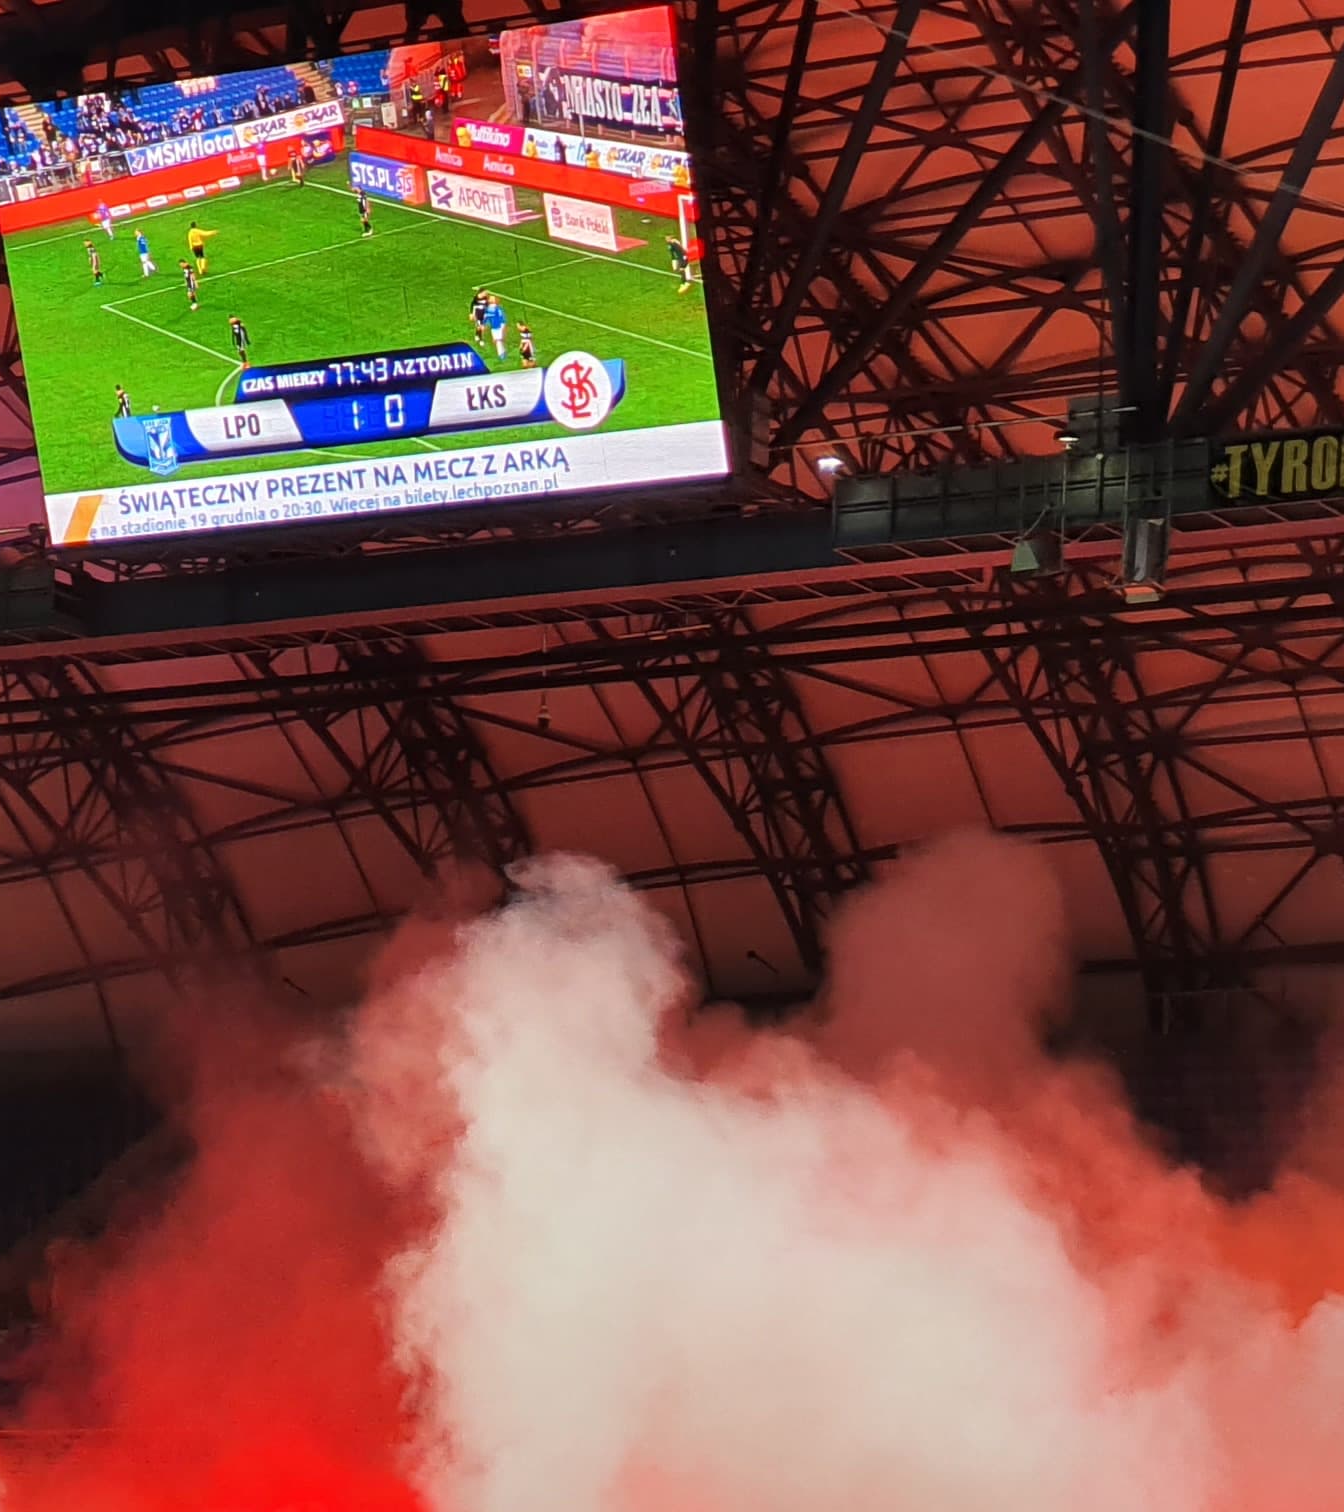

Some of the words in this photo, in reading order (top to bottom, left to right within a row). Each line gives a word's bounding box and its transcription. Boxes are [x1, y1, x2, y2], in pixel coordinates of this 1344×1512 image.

[146, 135, 235, 169] MSMflota
[351, 161, 394, 192] STS.PL
[458, 187, 504, 215] AFORTI
[241, 375, 274, 394] CZAS
[276, 370, 325, 389] MIERZY
[328, 357, 389, 387] 77:43
[392, 350, 476, 376] AZTORIN
[383, 394, 404, 429] 0
[466, 383, 507, 411] ŁKS
[222, 413, 261, 440] LPO
[118, 479, 260, 519] ŚWIĄTECZNY
[266, 468, 367, 500] PREZENT
[374, 465, 408, 487] NA
[414, 456, 474, 482] MECZ
[476, 454, 495, 475] Z
[503, 445, 572, 473] ARKĄ
[121, 514, 187, 534] stadionie
[190, 513, 207, 527] 19
[211, 507, 266, 528] grudnia
[329, 490, 381, 513] Więcej
[384, 494, 401, 507] na
[403, 473, 560, 505] bilety.lechpoznan.pl
